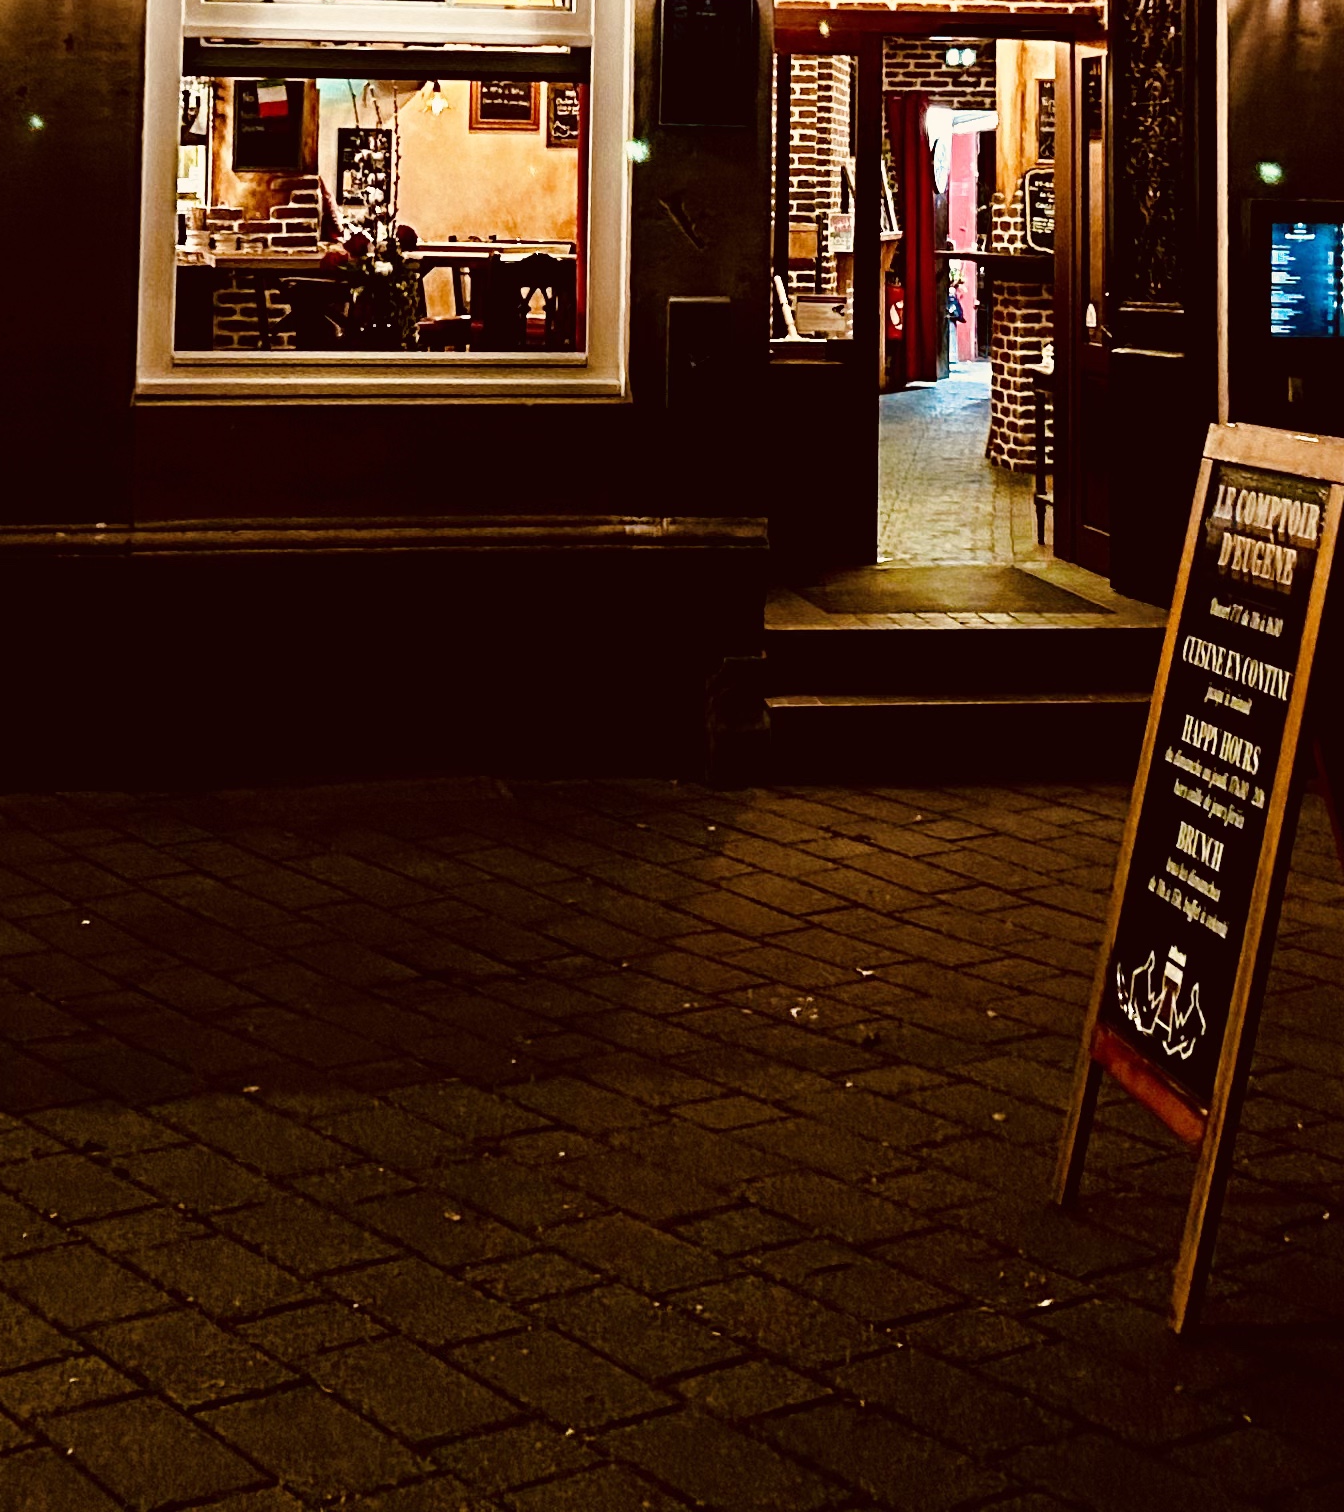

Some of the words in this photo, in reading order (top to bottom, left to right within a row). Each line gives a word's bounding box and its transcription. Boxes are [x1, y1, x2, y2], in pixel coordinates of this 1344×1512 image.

[1213, 485, 1236, 520] LE
[1235, 490, 1320, 541] COMPTOIR
[1182, 635, 1226, 675] CUISINE
[1181, 714, 1219, 755] HAPPY
[1218, 731, 1261, 775] HOURS
[1176, 821, 1224, 872] BRUNCH
